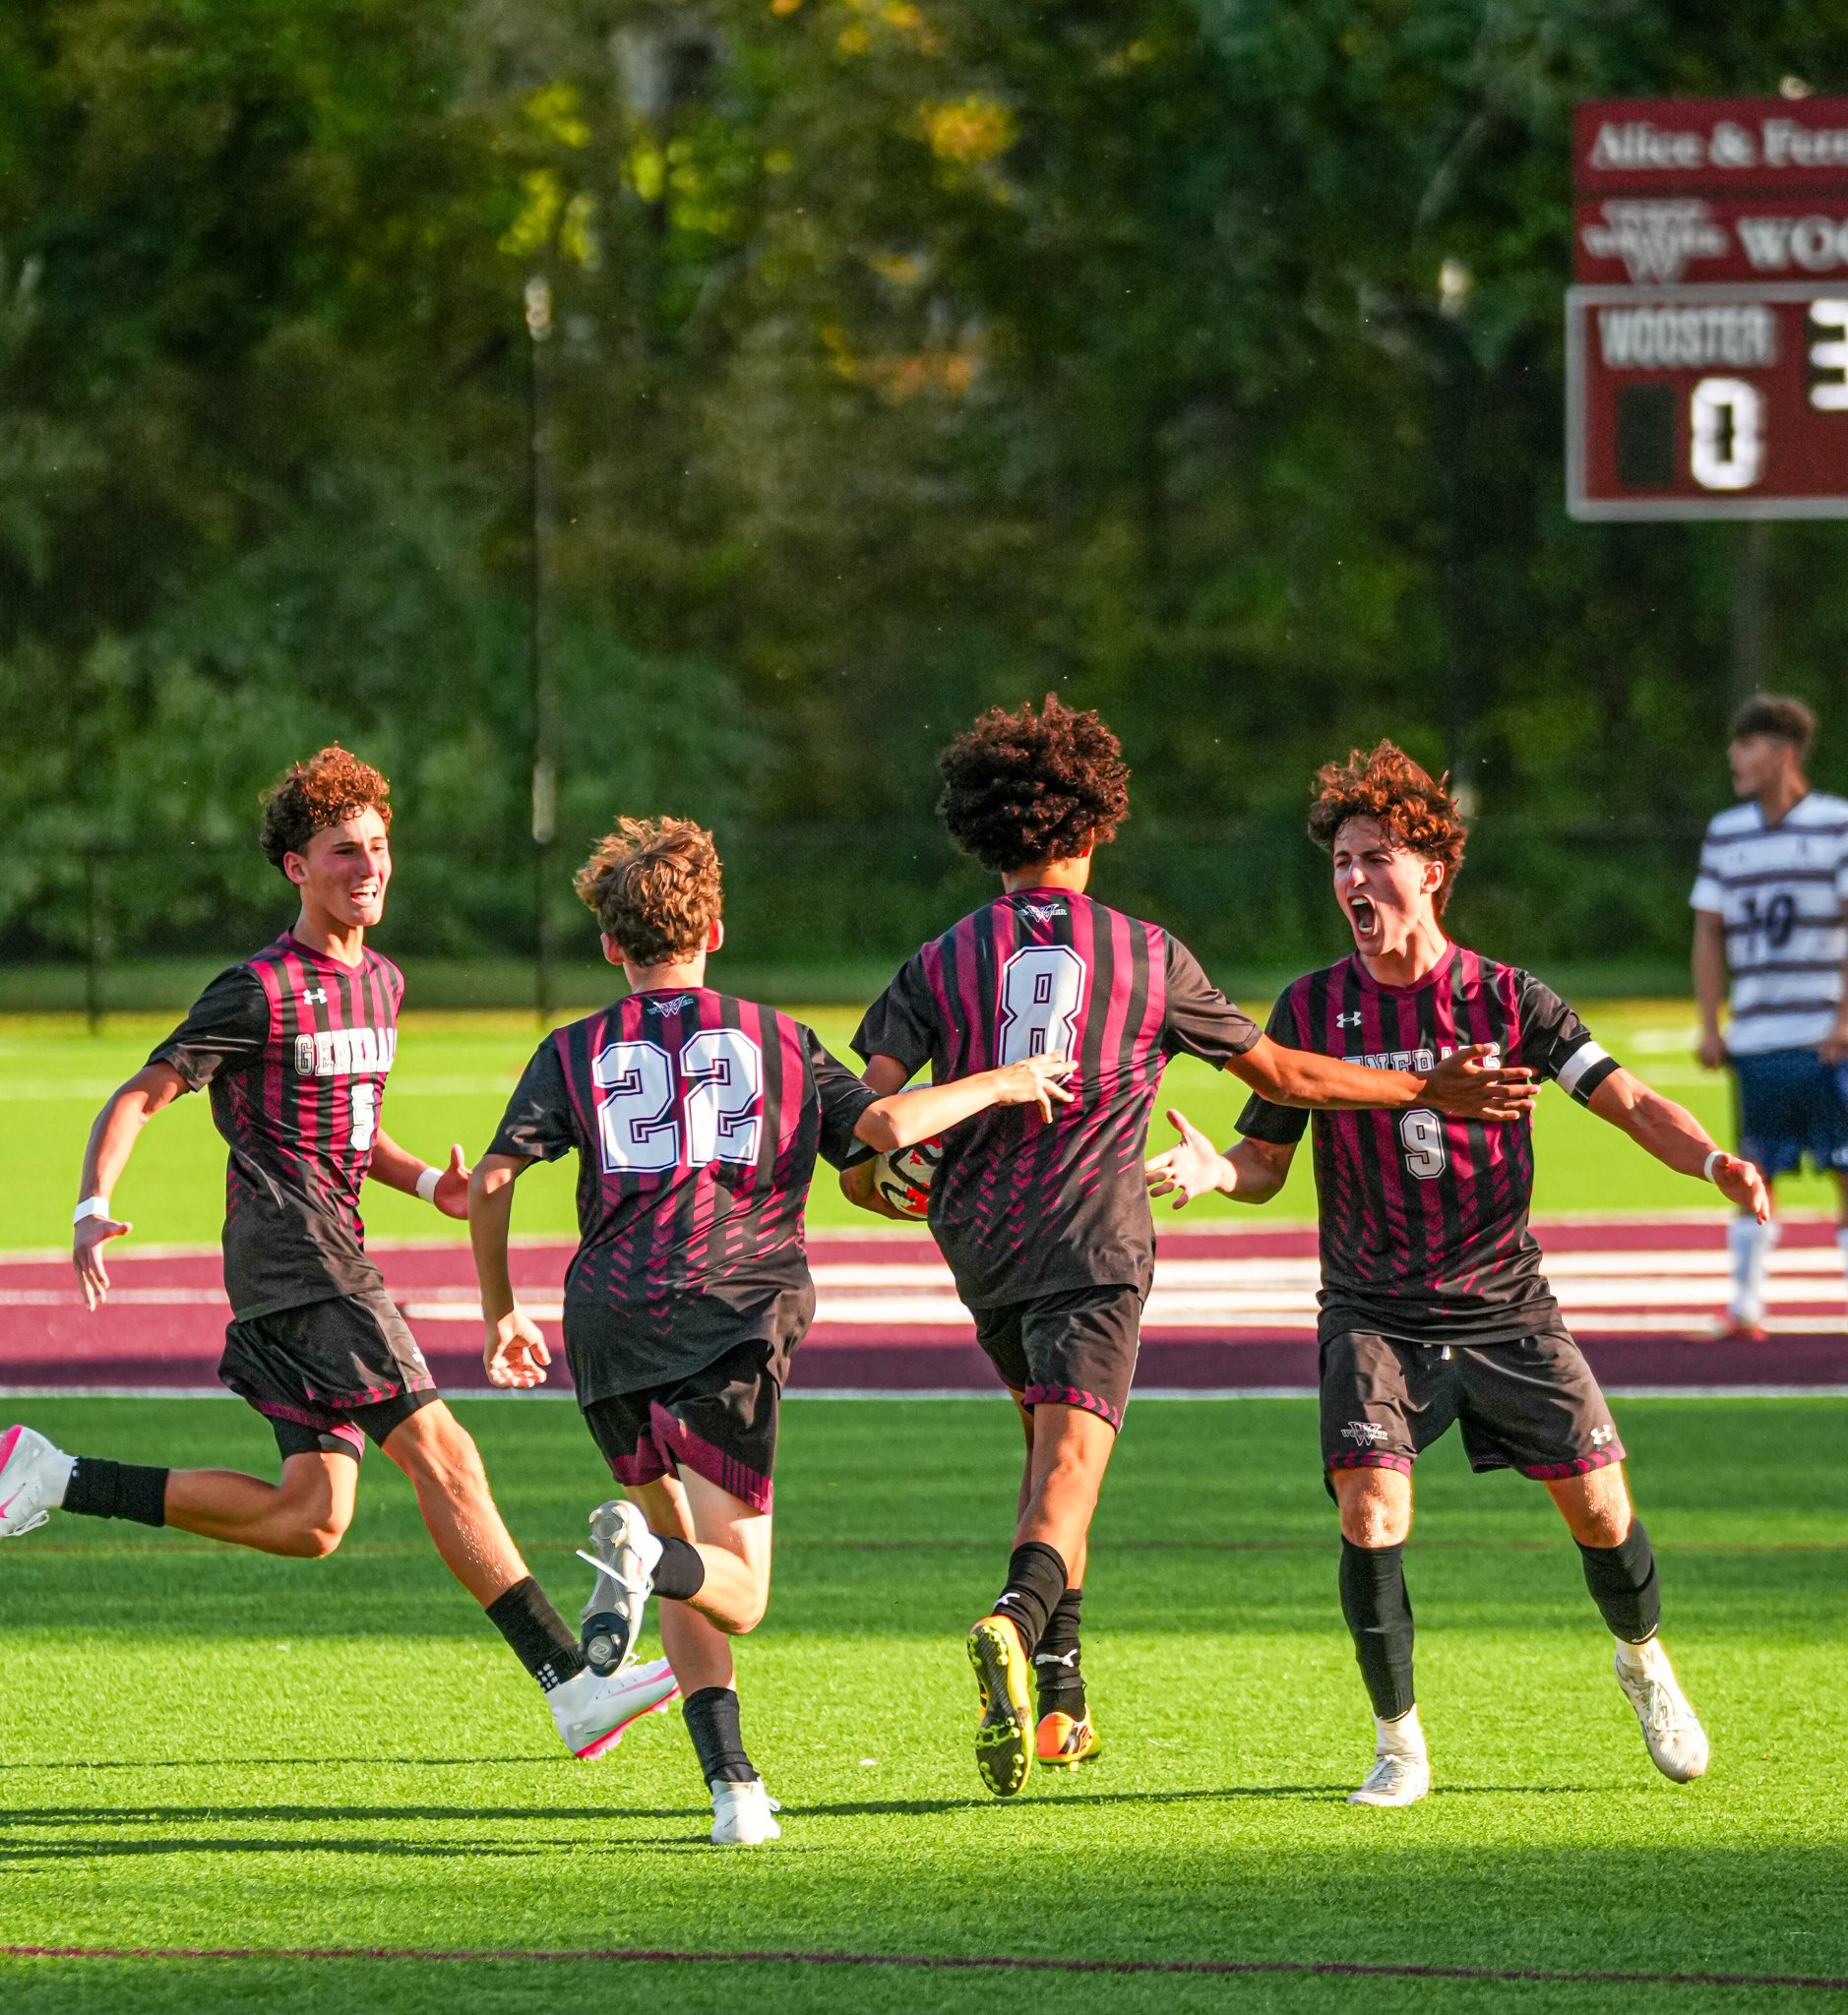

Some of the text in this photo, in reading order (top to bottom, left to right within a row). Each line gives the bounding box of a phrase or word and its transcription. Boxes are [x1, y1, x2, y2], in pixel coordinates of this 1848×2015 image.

[1591, 121, 1703, 169] Alice
[1709, 120, 1756, 168] &
[1738, 215, 1848, 271] WO
[1598, 305, 1777, 368] WOOSTER
[1690, 378, 1760, 491] 0
[1743, 893, 1796, 961] 10
[998, 945, 1086, 1087] 8
[592, 1028, 764, 1175] 22
[1399, 1109, 1447, 1181] 9
